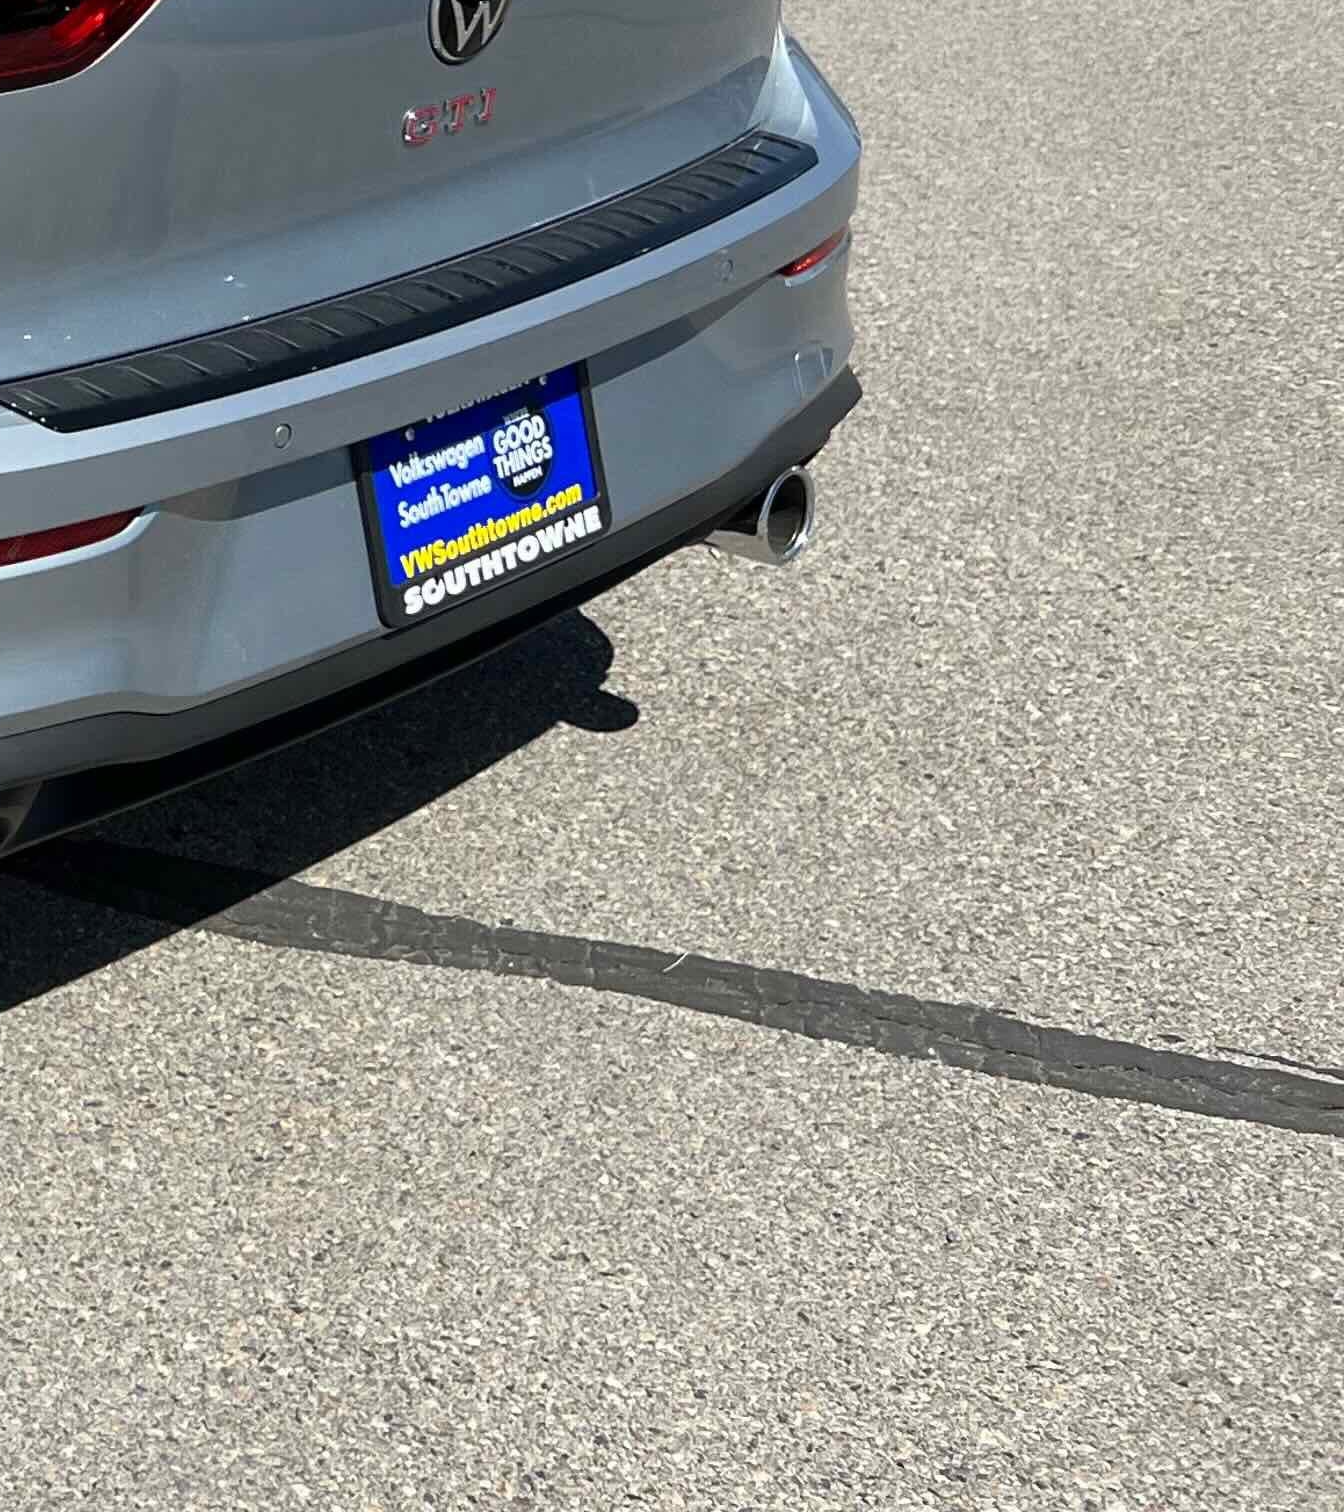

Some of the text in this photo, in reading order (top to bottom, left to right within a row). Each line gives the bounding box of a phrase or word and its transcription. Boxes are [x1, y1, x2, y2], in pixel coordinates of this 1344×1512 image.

[402, 87, 497, 145] GTI
[389, 434, 486, 488] Volkswagen
[492, 415, 545, 455] GOOD
[492, 436, 553, 479] THINGS
[397, 474, 492, 528] SouthTowne
[400, 483, 583, 578] VWSouthtowne.com
[403, 504, 602, 615] SOUTHTOWNE
